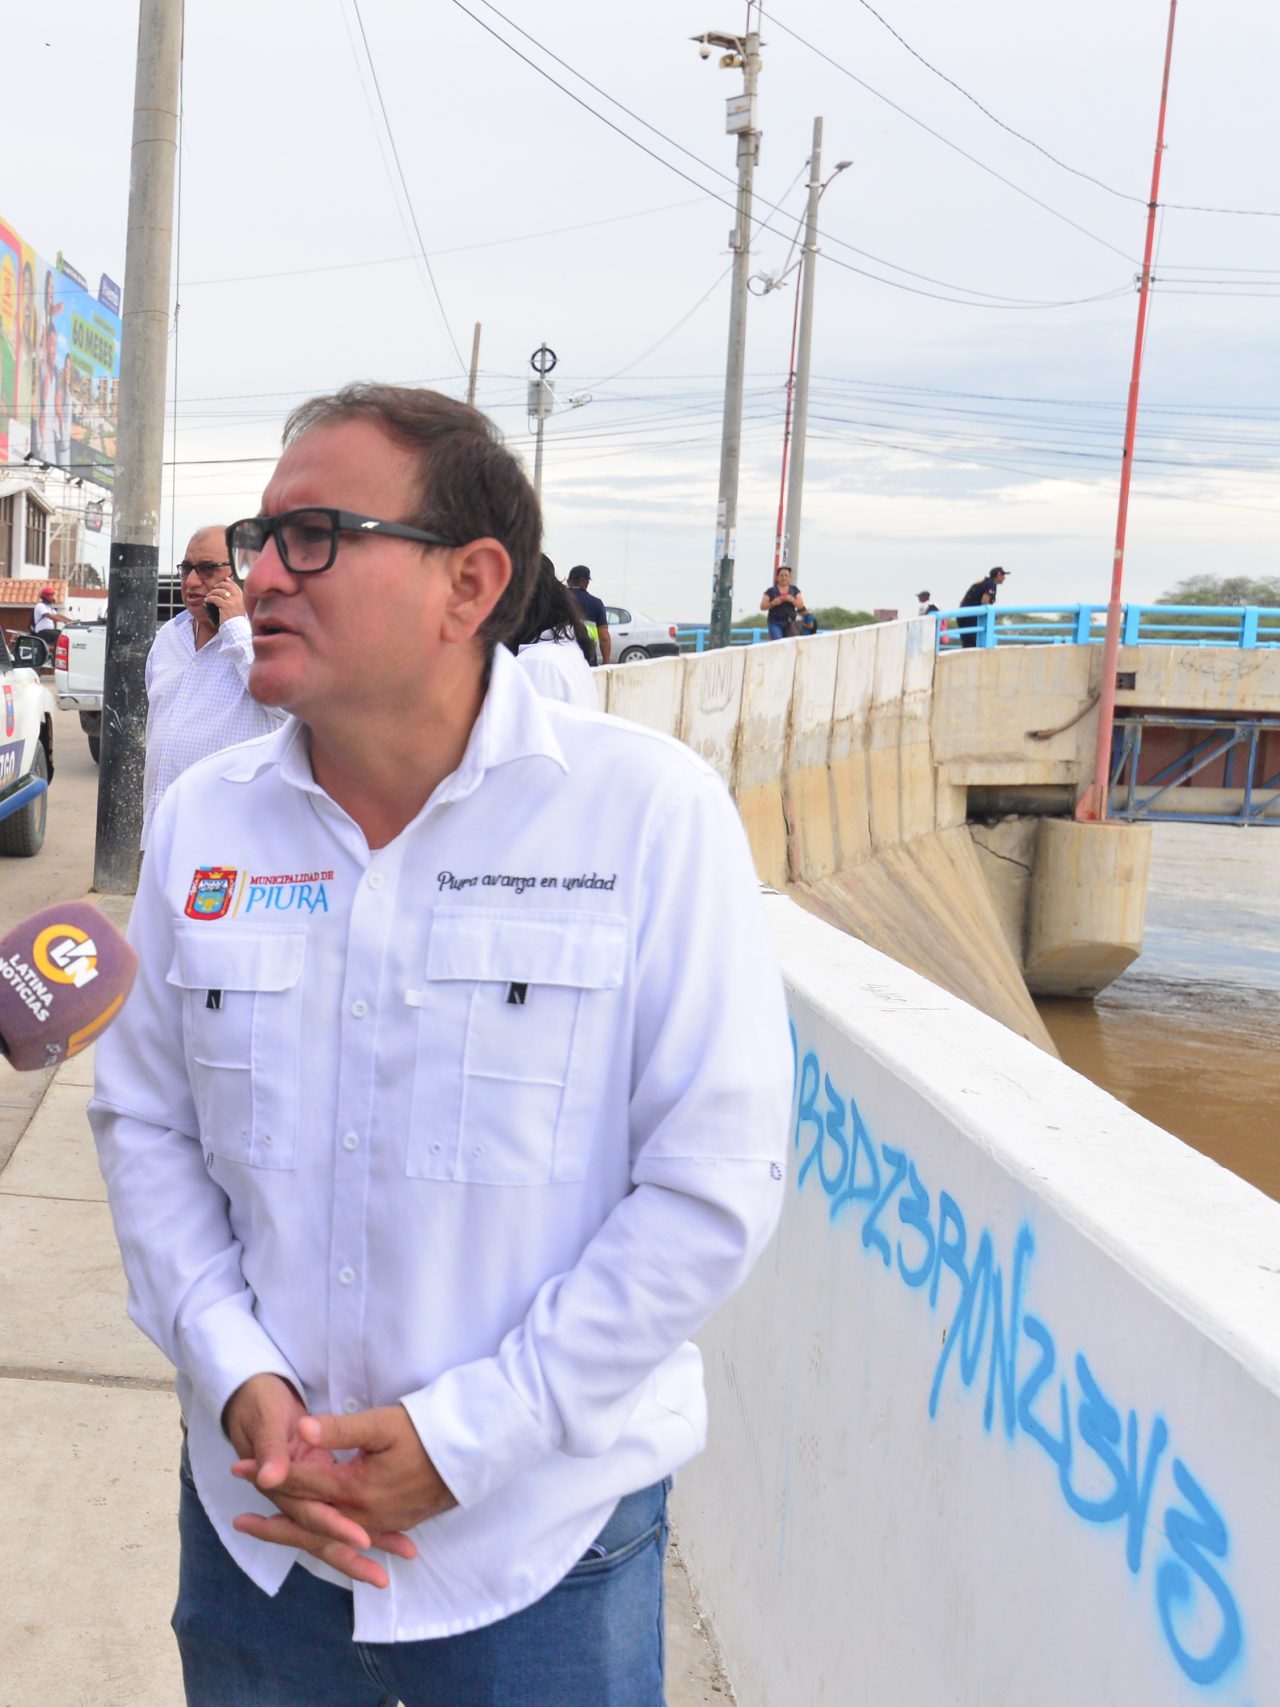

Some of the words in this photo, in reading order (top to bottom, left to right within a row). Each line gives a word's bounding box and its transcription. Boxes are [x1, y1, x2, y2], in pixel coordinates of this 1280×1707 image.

[73, 319, 85, 350] 60
[86, 326, 114, 369] MESES
[249, 871, 319, 885] MUNICIPALIDAD
[321, 870, 334, 881] DE
[437, 871, 478, 892] Piura
[482, 874, 536, 895] avanza
[540, 875, 557, 888] en
[562, 871, 617, 891] unidad
[245, 883, 329, 914] PIURA
[9, 953, 55, 1007] LATINA
